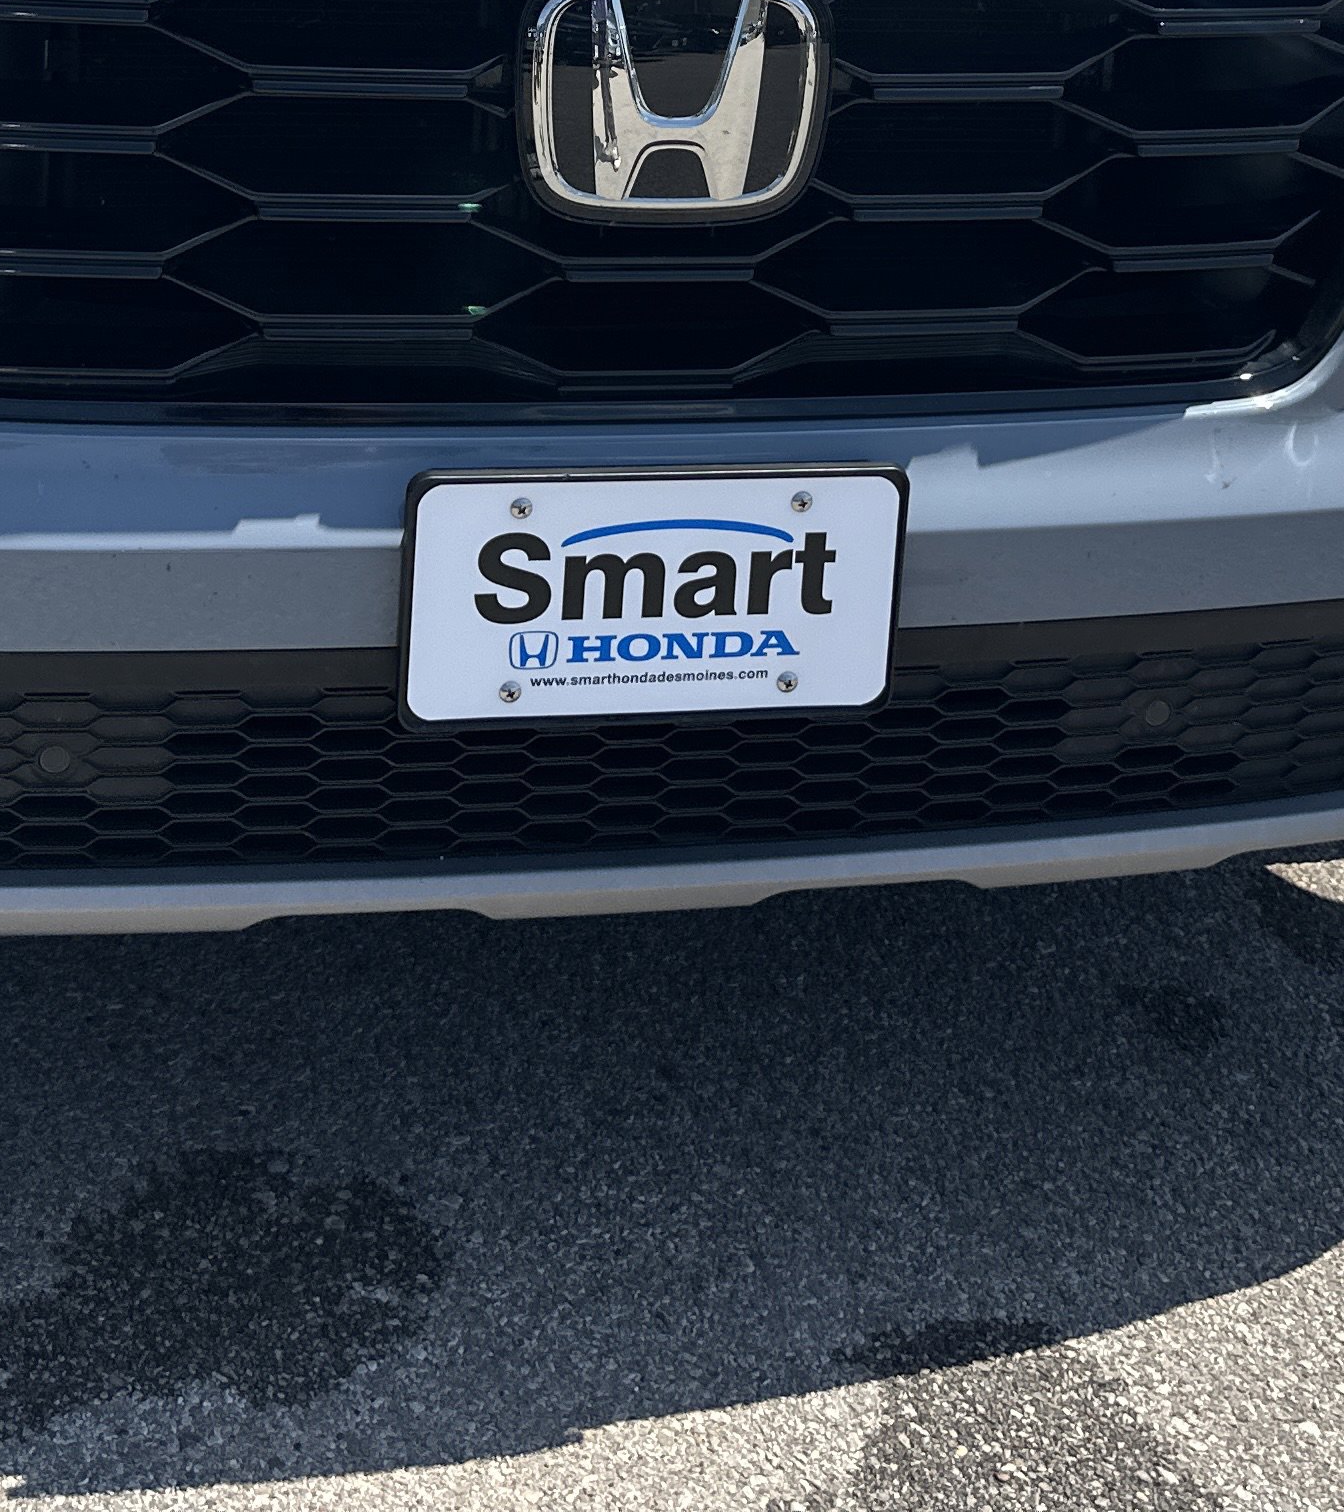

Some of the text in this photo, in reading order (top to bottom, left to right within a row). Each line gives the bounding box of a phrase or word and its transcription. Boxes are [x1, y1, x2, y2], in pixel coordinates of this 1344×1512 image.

[474, 532, 837, 624] Smart
[567, 630, 800, 663] HONDA
[530, 668, 769, 687] www.smarthondadesmoines.com
